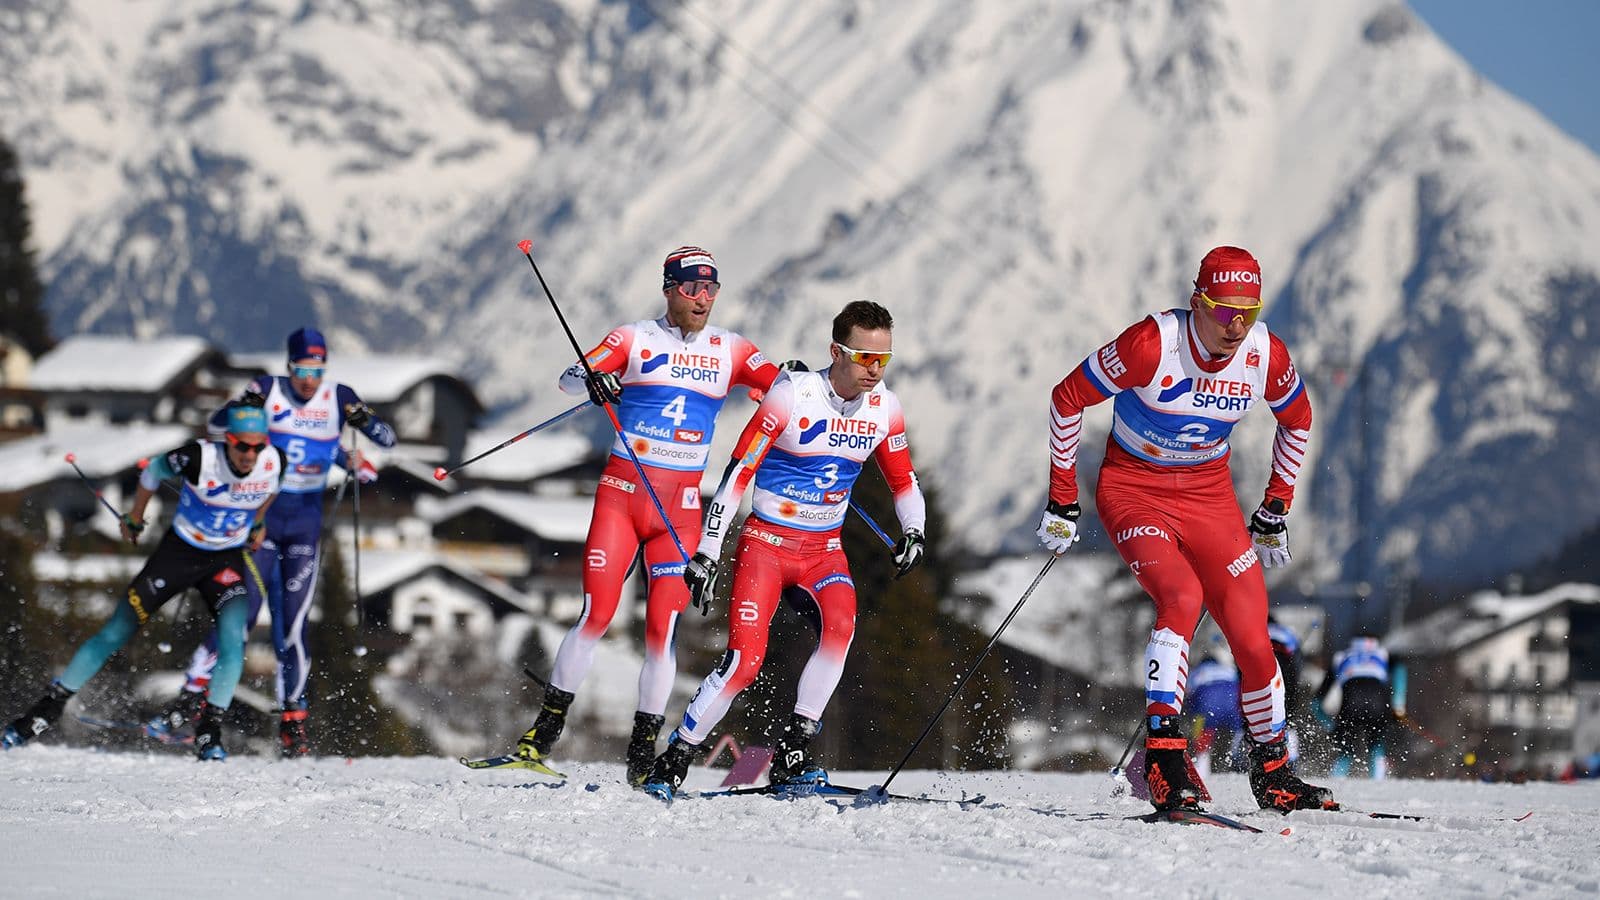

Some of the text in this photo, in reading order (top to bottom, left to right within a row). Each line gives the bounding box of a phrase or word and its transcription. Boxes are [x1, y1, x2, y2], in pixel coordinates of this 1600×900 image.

[1212, 270, 1260, 285] LUKOIL
[672, 353, 720, 370] INTER
[1101, 341, 1128, 379] RUS
[670, 366, 720, 383] SPORT
[1195, 377, 1253, 396] INTER
[660, 394, 687, 426] 4
[1192, 394, 1250, 411] SPORT
[294, 408, 329, 419] INTER
[634, 420, 670, 438] Seefeld
[831, 418, 878, 435] INTER
[1175, 422, 1210, 442] 2
[828, 433, 875, 450] SPORT
[287, 439, 306, 463] 5
[814, 463, 839, 489] 3
[232, 480, 270, 492] INTER
[783, 484, 821, 502] Seefeld
[211, 510, 249, 532] 13
[1116, 525, 1172, 545] LUKOIL
[1148, 659, 1161, 682] 2
